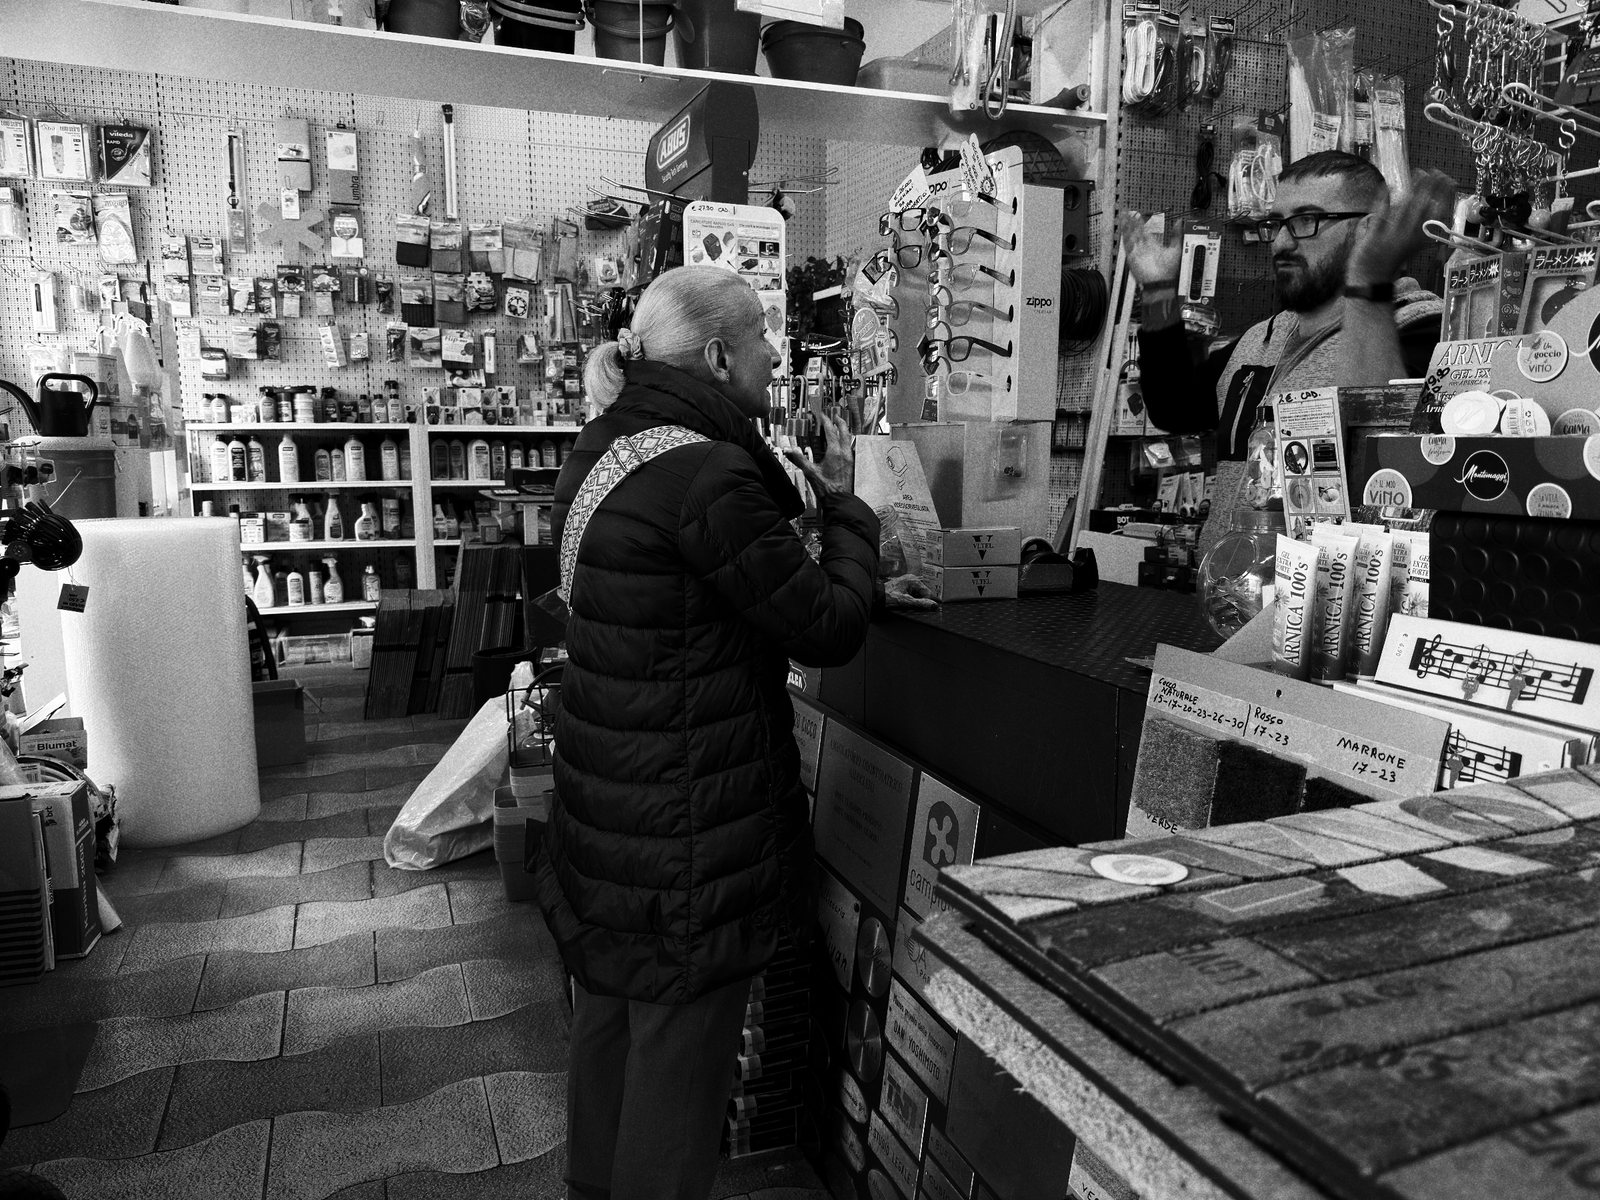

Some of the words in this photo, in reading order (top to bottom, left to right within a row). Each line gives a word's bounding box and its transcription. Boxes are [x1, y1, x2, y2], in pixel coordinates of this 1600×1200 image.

[109, 129, 133, 138] vileda
[660, 122, 687, 163] ABUS
[350, 175, 360, 200] umbra
[928, 181, 948, 196] ppo
[1026, 295, 1052, 309] zippo
[1534, 350, 1562, 359] goccio
[1450, 368, 1472, 380] GEL
[1281, 550, 1291, 560] GEL
[1412, 560, 1429, 569] EXTR
[1329, 552, 1348, 590] 100's
[1365, 549, 1384, 586] 100's
[1291, 563, 1308, 600] 100's
[1322, 596, 1343, 657] ARNICA
[1355, 590, 1377, 653] ARNICA
[1283, 606, 1304, 666] ARNICA
[1161, 685, 1199, 705] NATURALE
[1153, 693, 1244, 730] 15-17-20-23-26-30
[37, 740, 77, 751] Blumat
[1336, 737, 1406, 770] MARRONE
[1352, 762, 1397, 783] 17-23
[1145, 813, 1178, 835] VERDE
[908, 1035, 941, 1081] YOSHIMOTO
